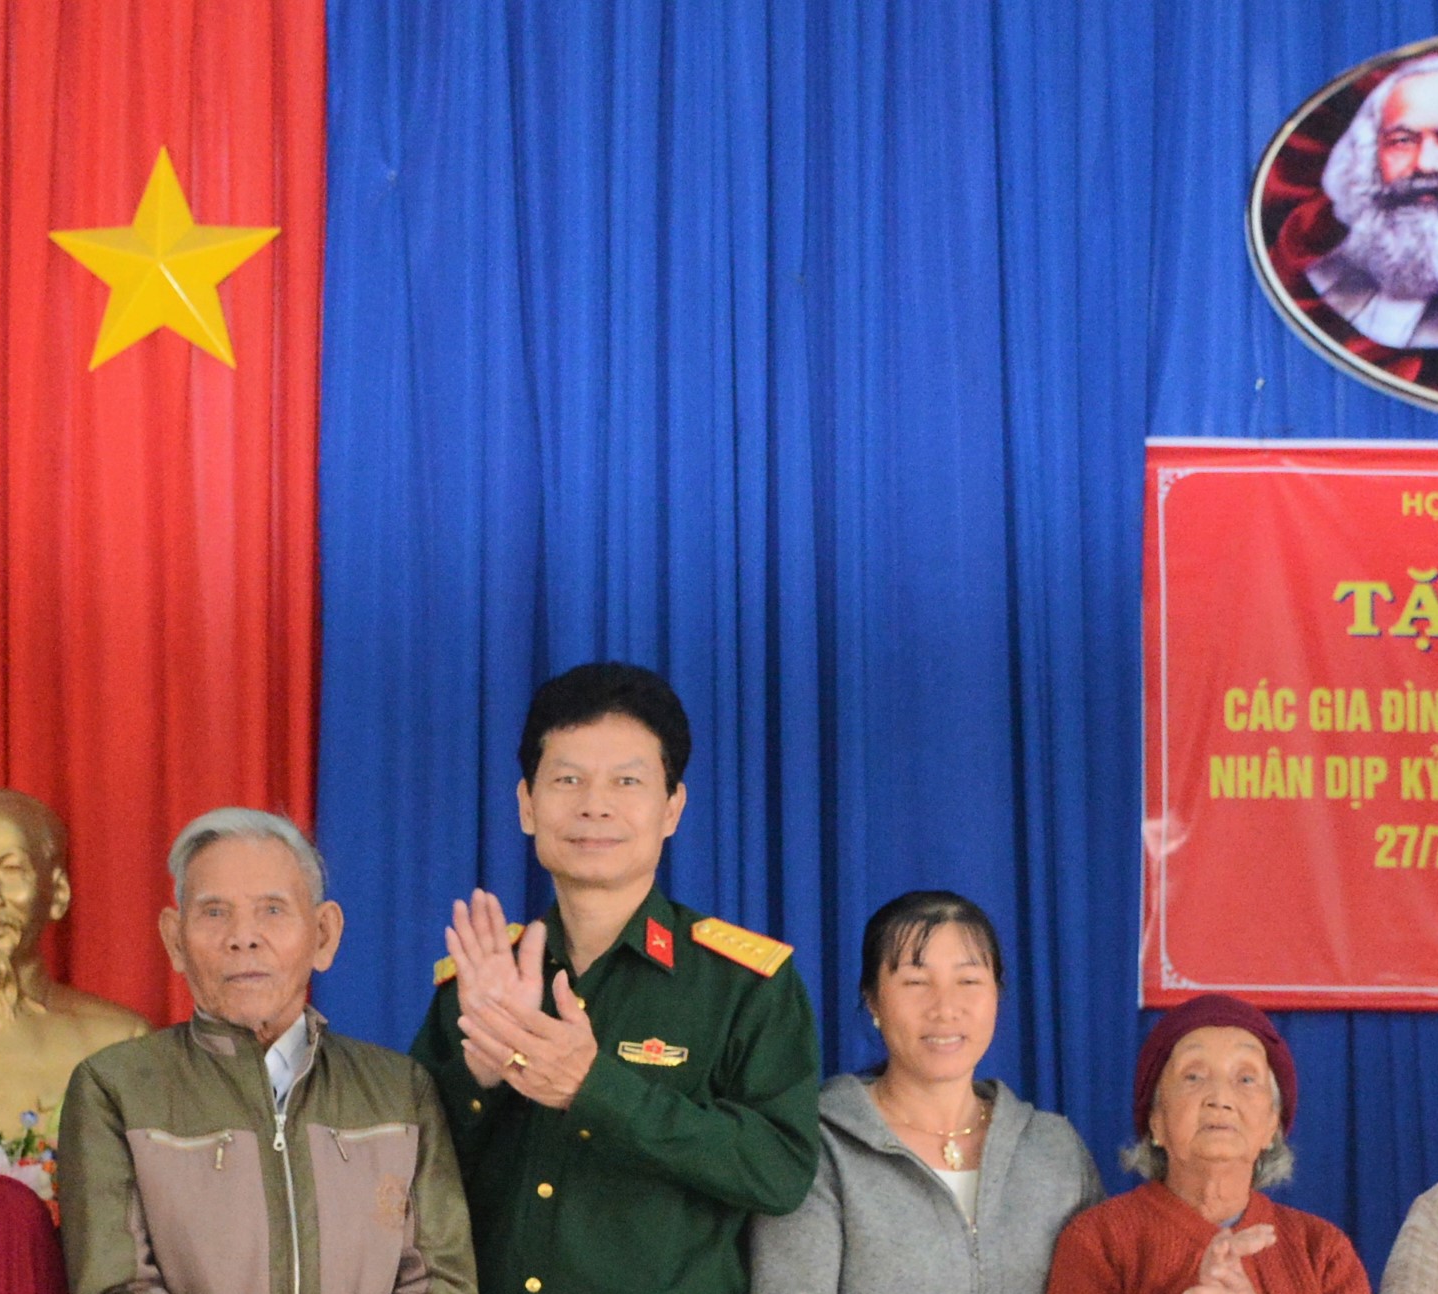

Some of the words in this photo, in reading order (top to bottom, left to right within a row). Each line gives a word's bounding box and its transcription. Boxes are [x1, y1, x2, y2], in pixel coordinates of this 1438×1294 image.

[1223, 678, 1298, 733] CÁC
[1308, 687, 1372, 733] GIA
[1209, 746, 1314, 799] NHÂN
[1324, 756, 1388, 810] DỊP
